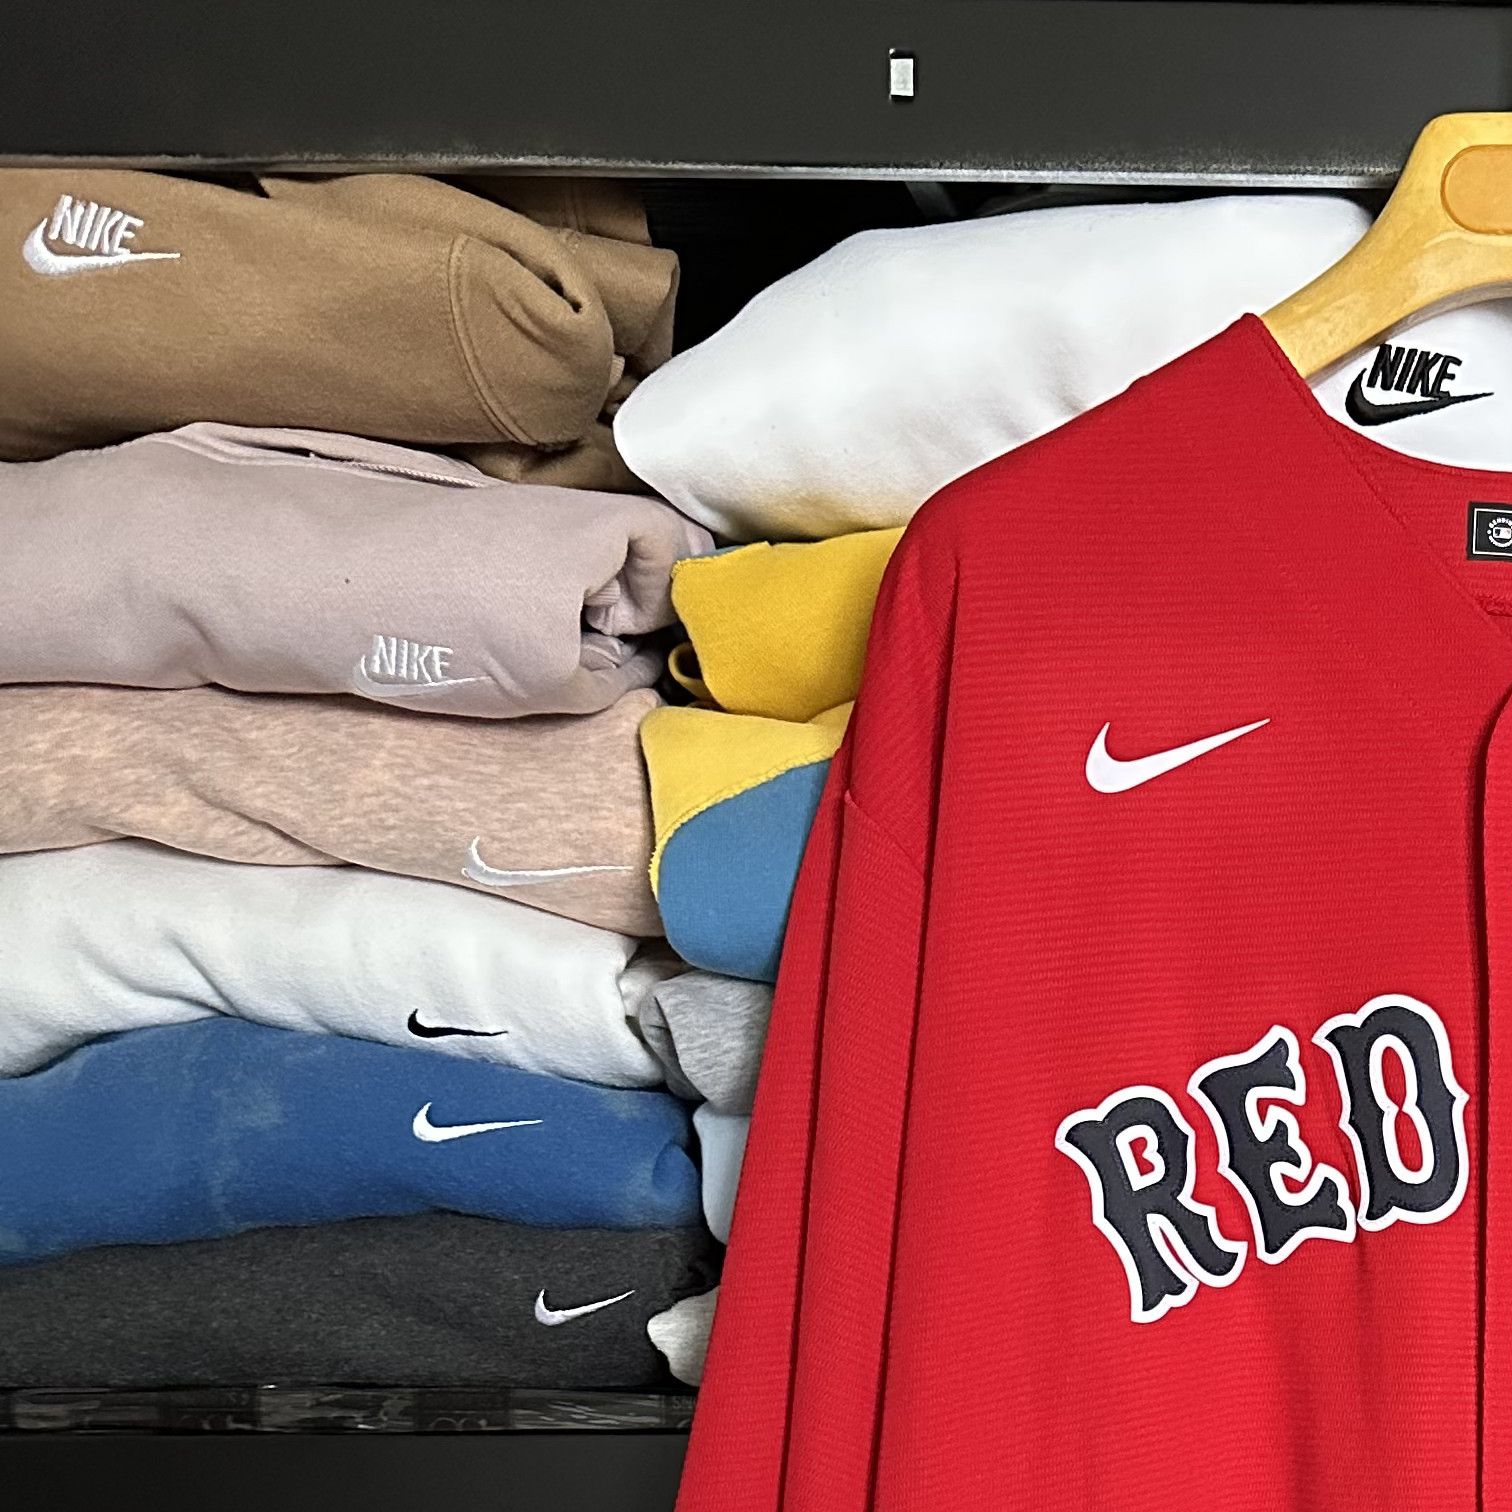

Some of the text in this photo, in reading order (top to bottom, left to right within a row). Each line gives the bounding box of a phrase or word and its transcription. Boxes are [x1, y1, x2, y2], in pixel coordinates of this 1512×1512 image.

[48, 194, 144, 255] NIKE
[1366, 343, 1462, 399] NIKE
[371, 635, 454, 684] NIKE
[1054, 994, 1470, 1324] RED
